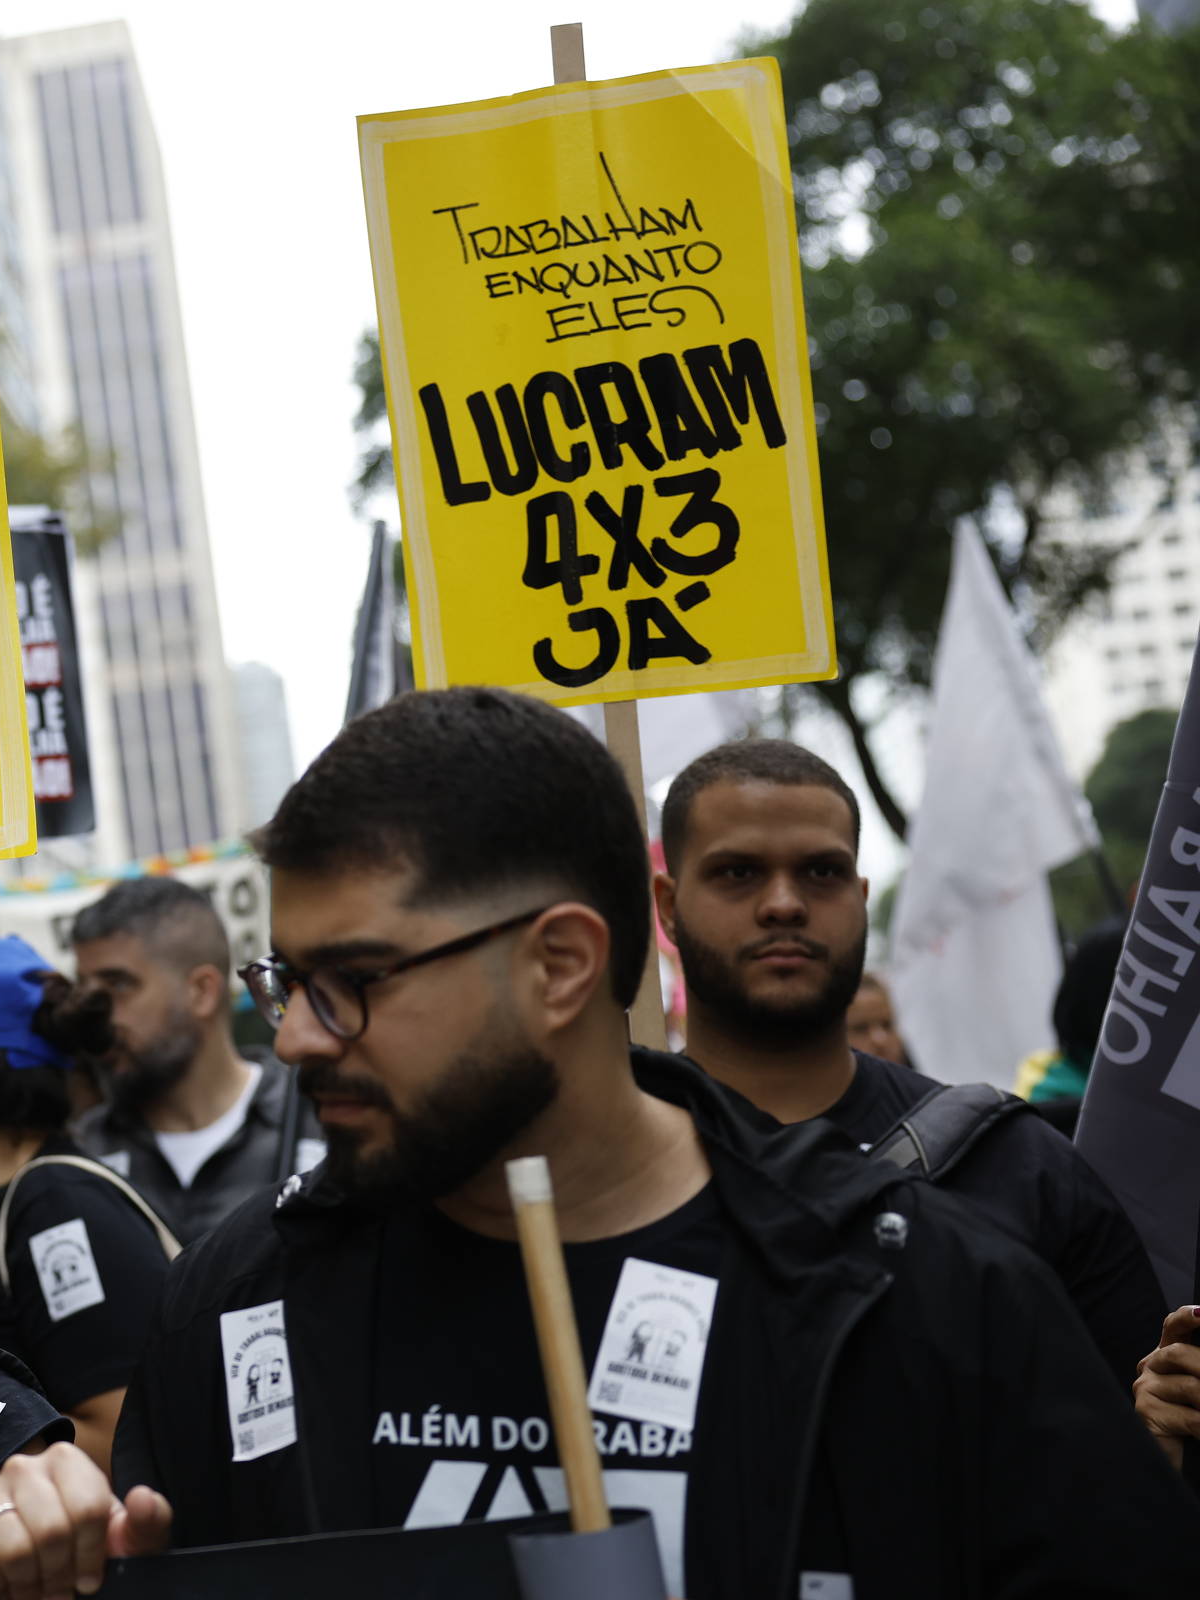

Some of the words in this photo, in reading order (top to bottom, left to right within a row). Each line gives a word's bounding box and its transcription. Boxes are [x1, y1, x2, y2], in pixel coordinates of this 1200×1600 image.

[485, 241, 722, 299] ENQUANTO
[546, 286, 725, 343] ELES
[418, 337, 787, 507] LUCRAM
[522, 468, 741, 606] 4X3
[532, 580, 712, 688] JÁ
[372, 1405, 480, 1448] ALÉM
[492, 1416, 548, 1451] DO
[593, 1419, 693, 1458] RABA
